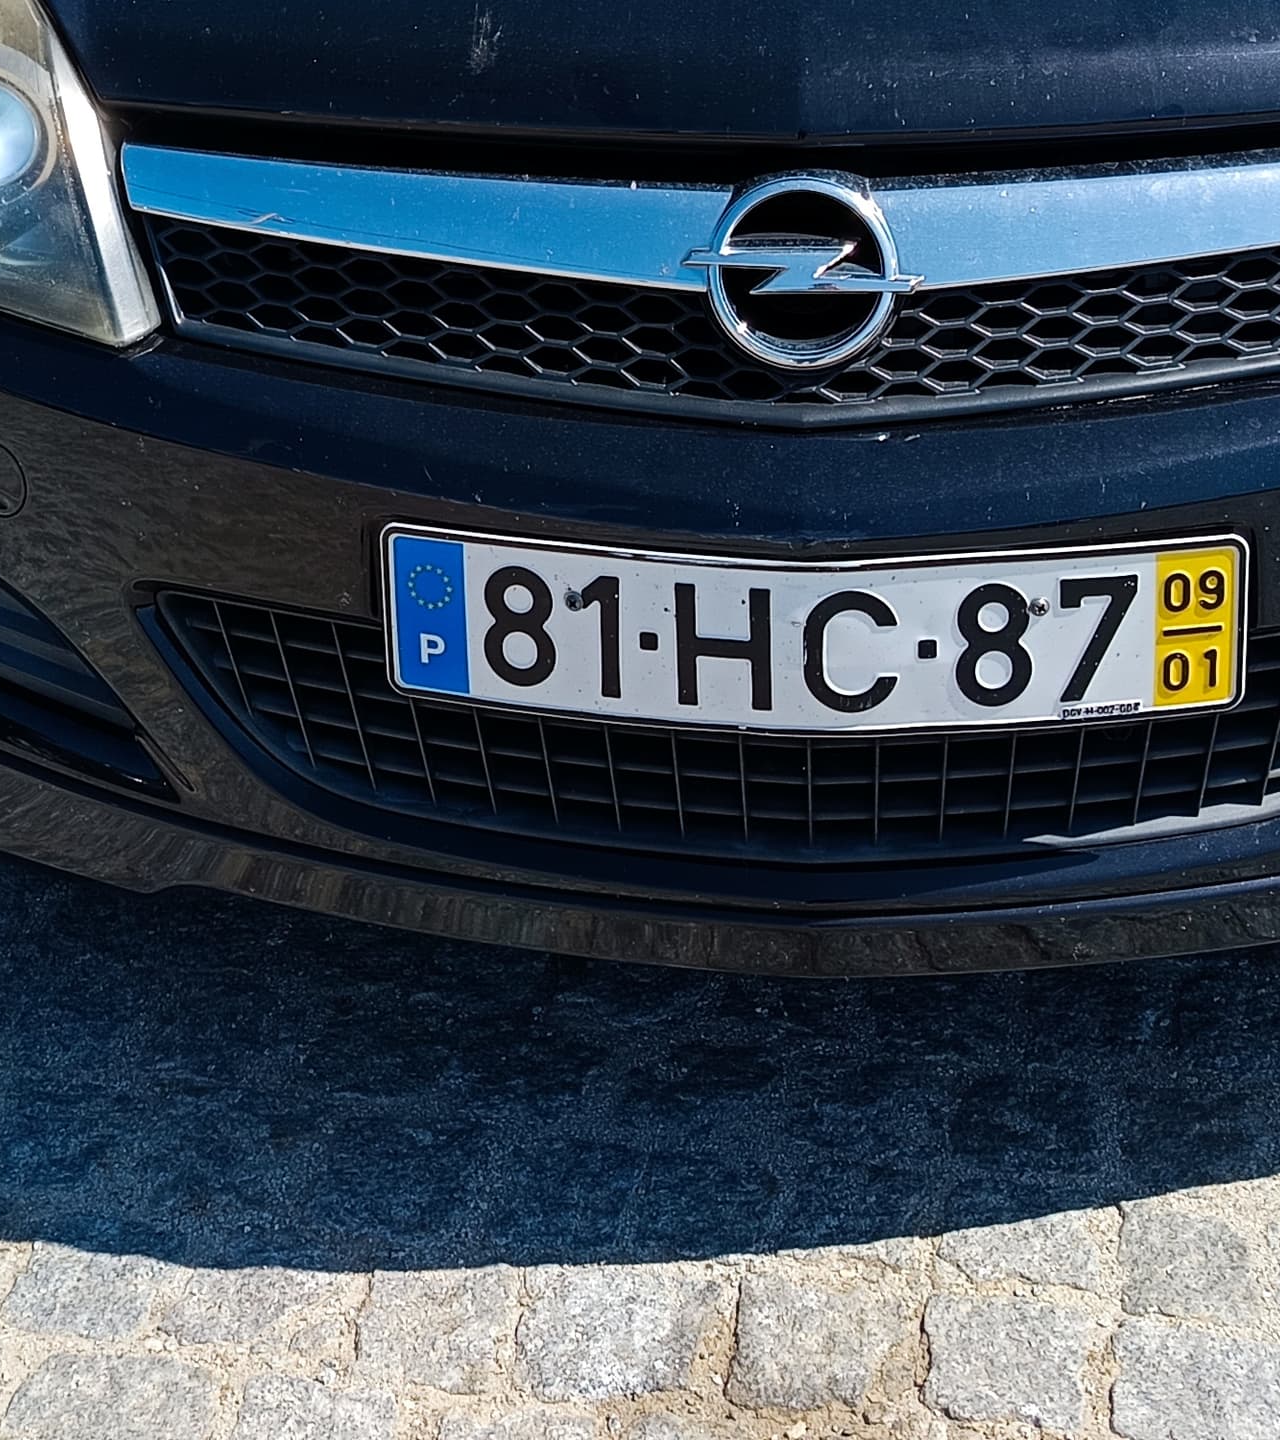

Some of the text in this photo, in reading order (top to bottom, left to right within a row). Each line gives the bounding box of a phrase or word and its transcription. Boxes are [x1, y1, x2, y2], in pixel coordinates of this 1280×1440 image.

[1163, 569, 1226, 613] 09
[420, 632, 446, 664] P
[1162, 648, 1218, 692] 01
